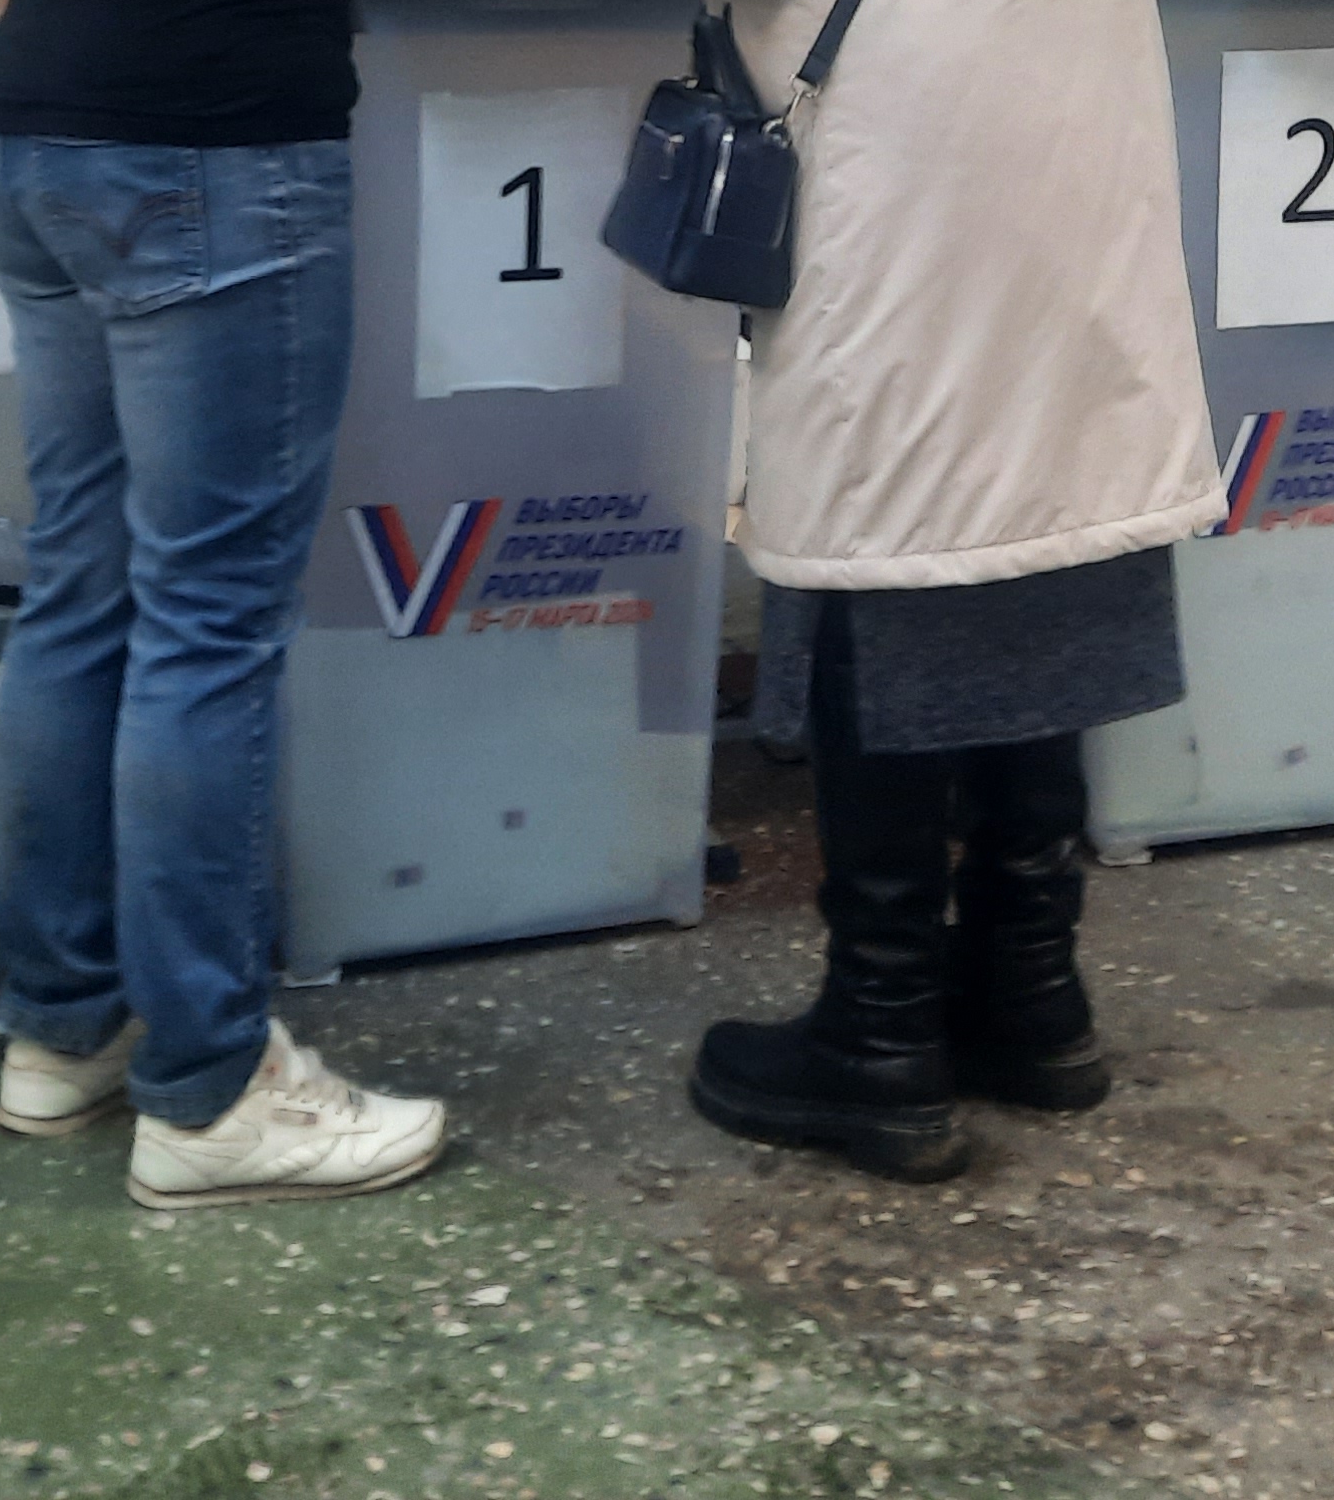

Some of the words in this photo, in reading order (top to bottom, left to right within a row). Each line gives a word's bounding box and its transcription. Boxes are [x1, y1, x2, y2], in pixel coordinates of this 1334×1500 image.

[499, 166, 563, 283] 1
[513, 493, 648, 524] ВЫБОРЫ
[495, 527, 684, 563] ПРЕЗИДЕНТА
[480, 568, 603, 600] РОССИИ
